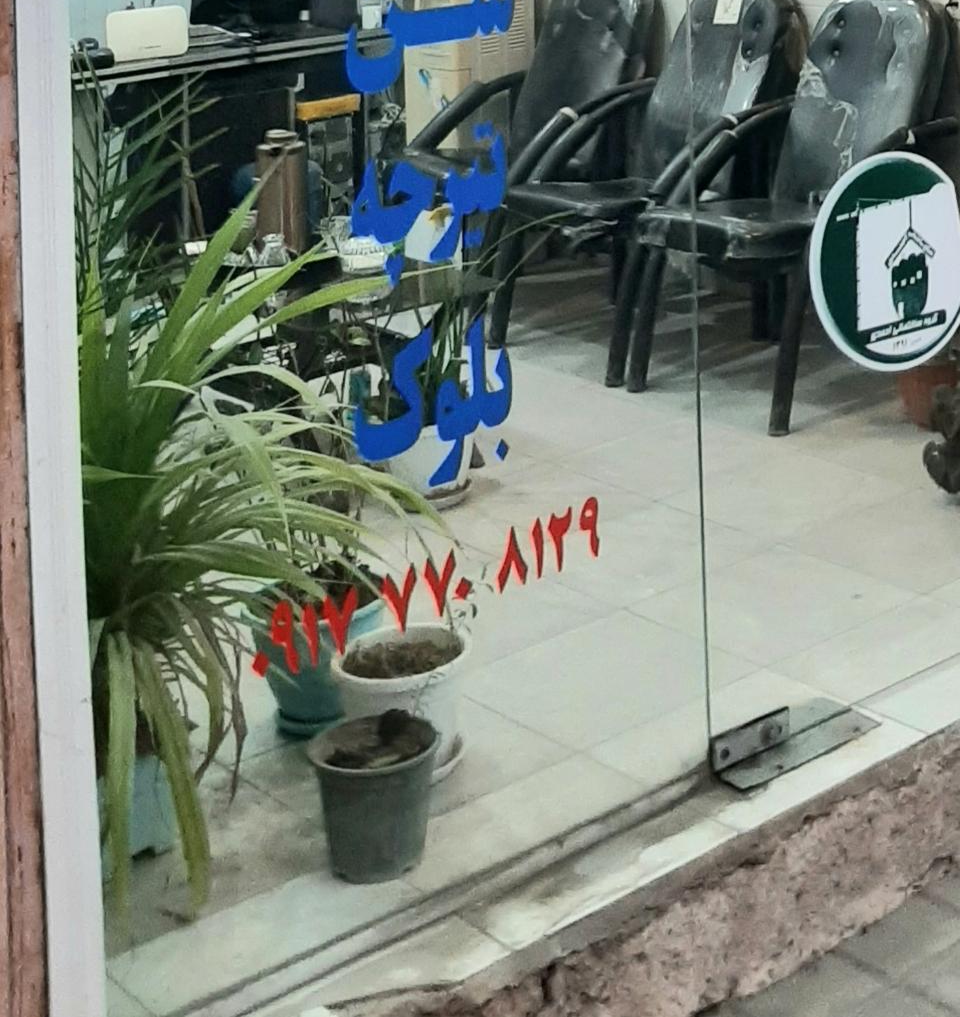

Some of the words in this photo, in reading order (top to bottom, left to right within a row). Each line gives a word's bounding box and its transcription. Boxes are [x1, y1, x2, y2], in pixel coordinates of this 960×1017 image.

[351, 120, 508, 288] تیرچه
[353, 315, 513, 487] بلوک
[252, 585, 359, 678] ۰۹۱۷
[380, 548, 474, 634] ۷۷۰
[496, 496, 600, 595] ۸۱۲۹
